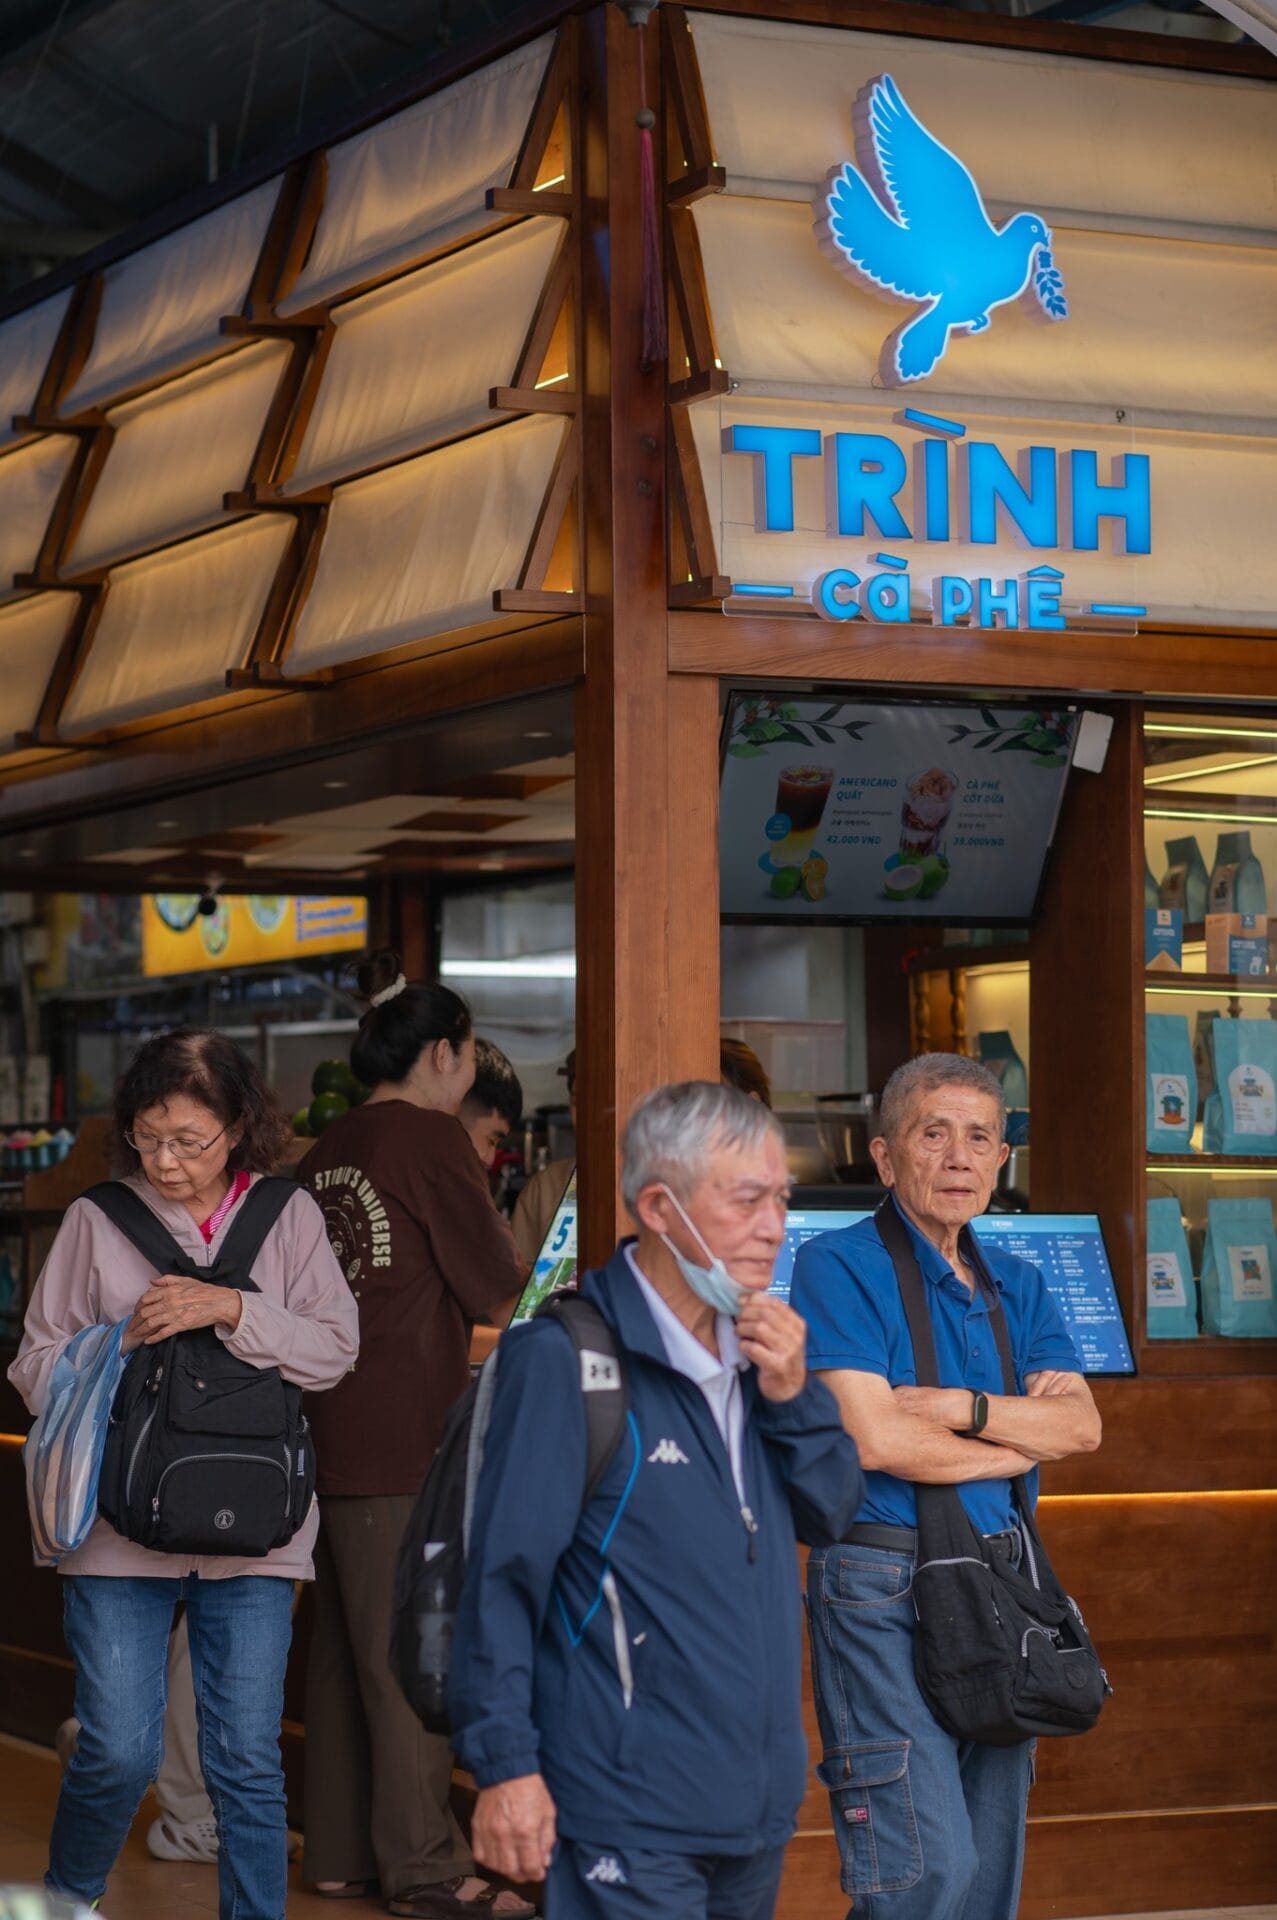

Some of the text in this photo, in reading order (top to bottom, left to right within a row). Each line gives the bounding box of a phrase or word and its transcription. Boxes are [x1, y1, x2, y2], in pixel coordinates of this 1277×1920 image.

[728, 407, 1152, 555] TRÌNH
[936, 564, 1067, 631] PHÊ
[839, 777, 898, 788] AMERICANO
[862, 836, 882, 846] VND
[551, 1216, 575, 1252] 5
